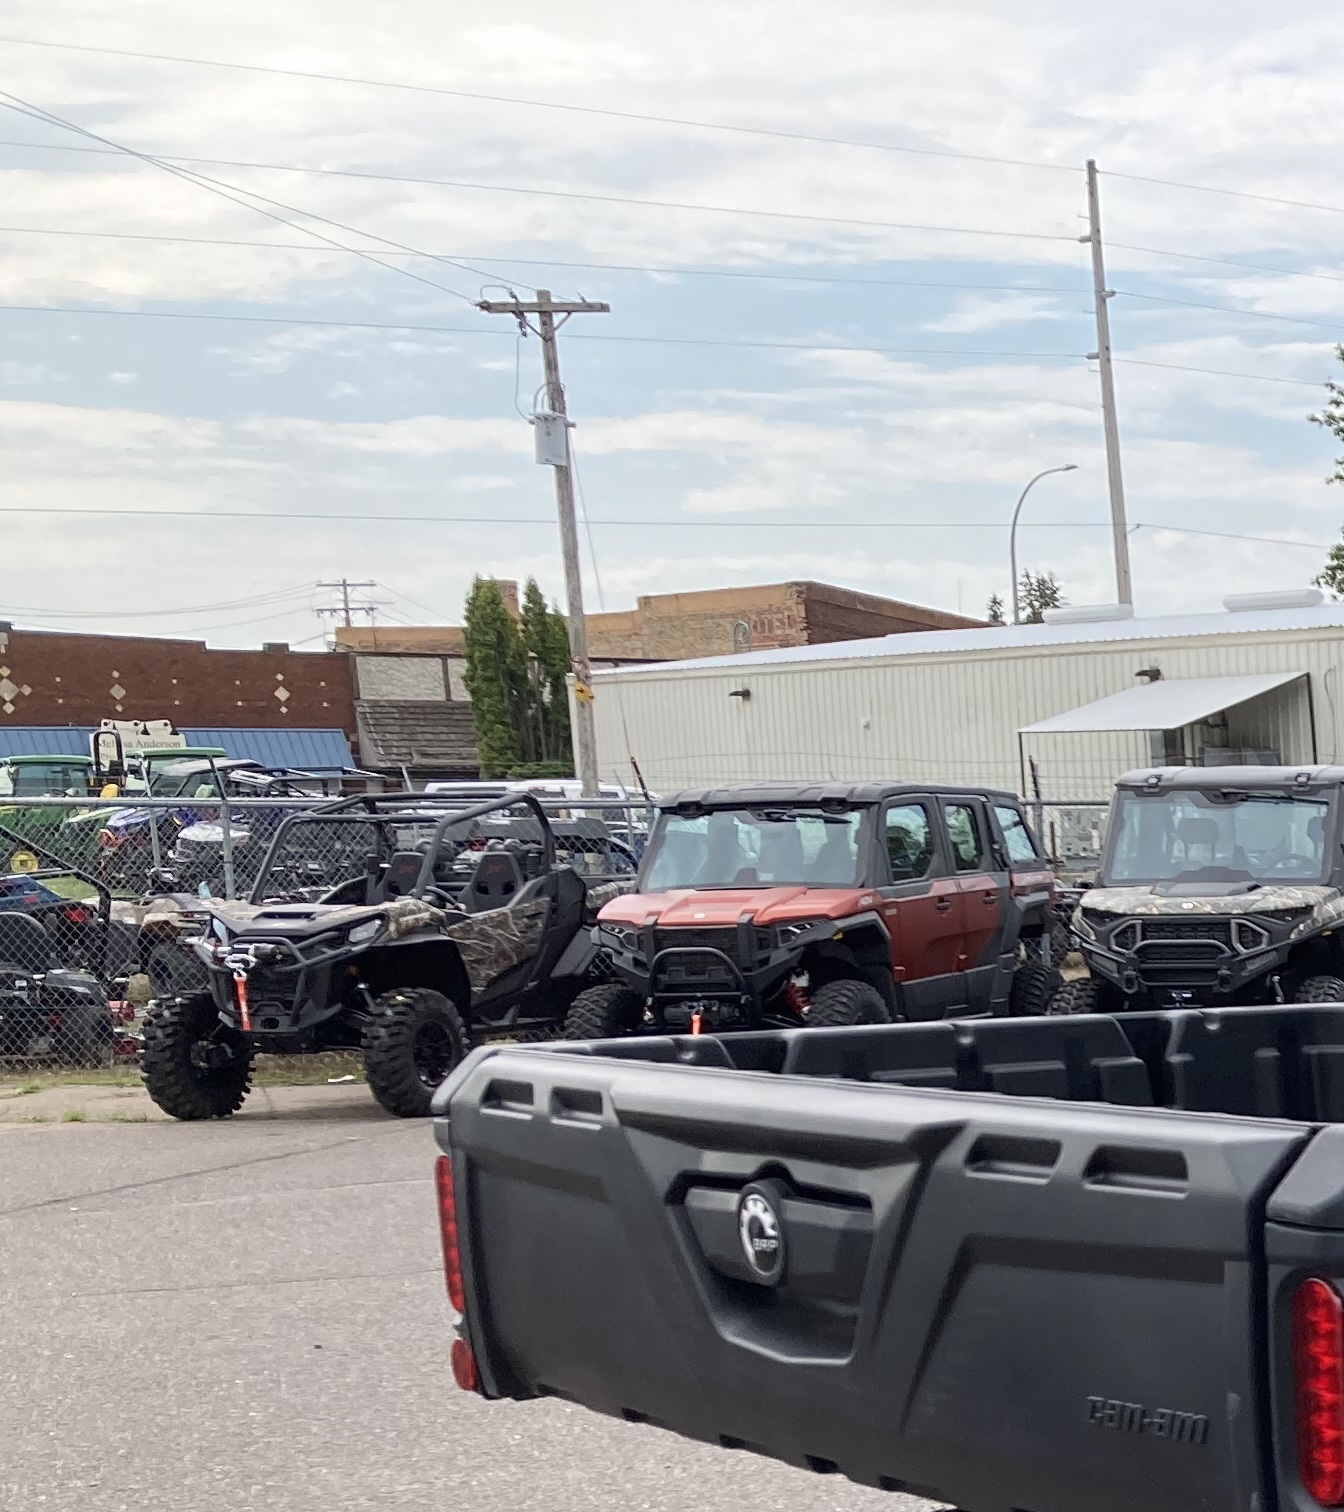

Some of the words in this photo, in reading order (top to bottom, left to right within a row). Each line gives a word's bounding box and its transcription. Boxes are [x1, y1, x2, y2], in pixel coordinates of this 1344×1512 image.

[136, 739, 181, 748] Anderson
[752, 1238, 779, 1252] BRP
[1086, 1395, 1209, 1445] can-am
